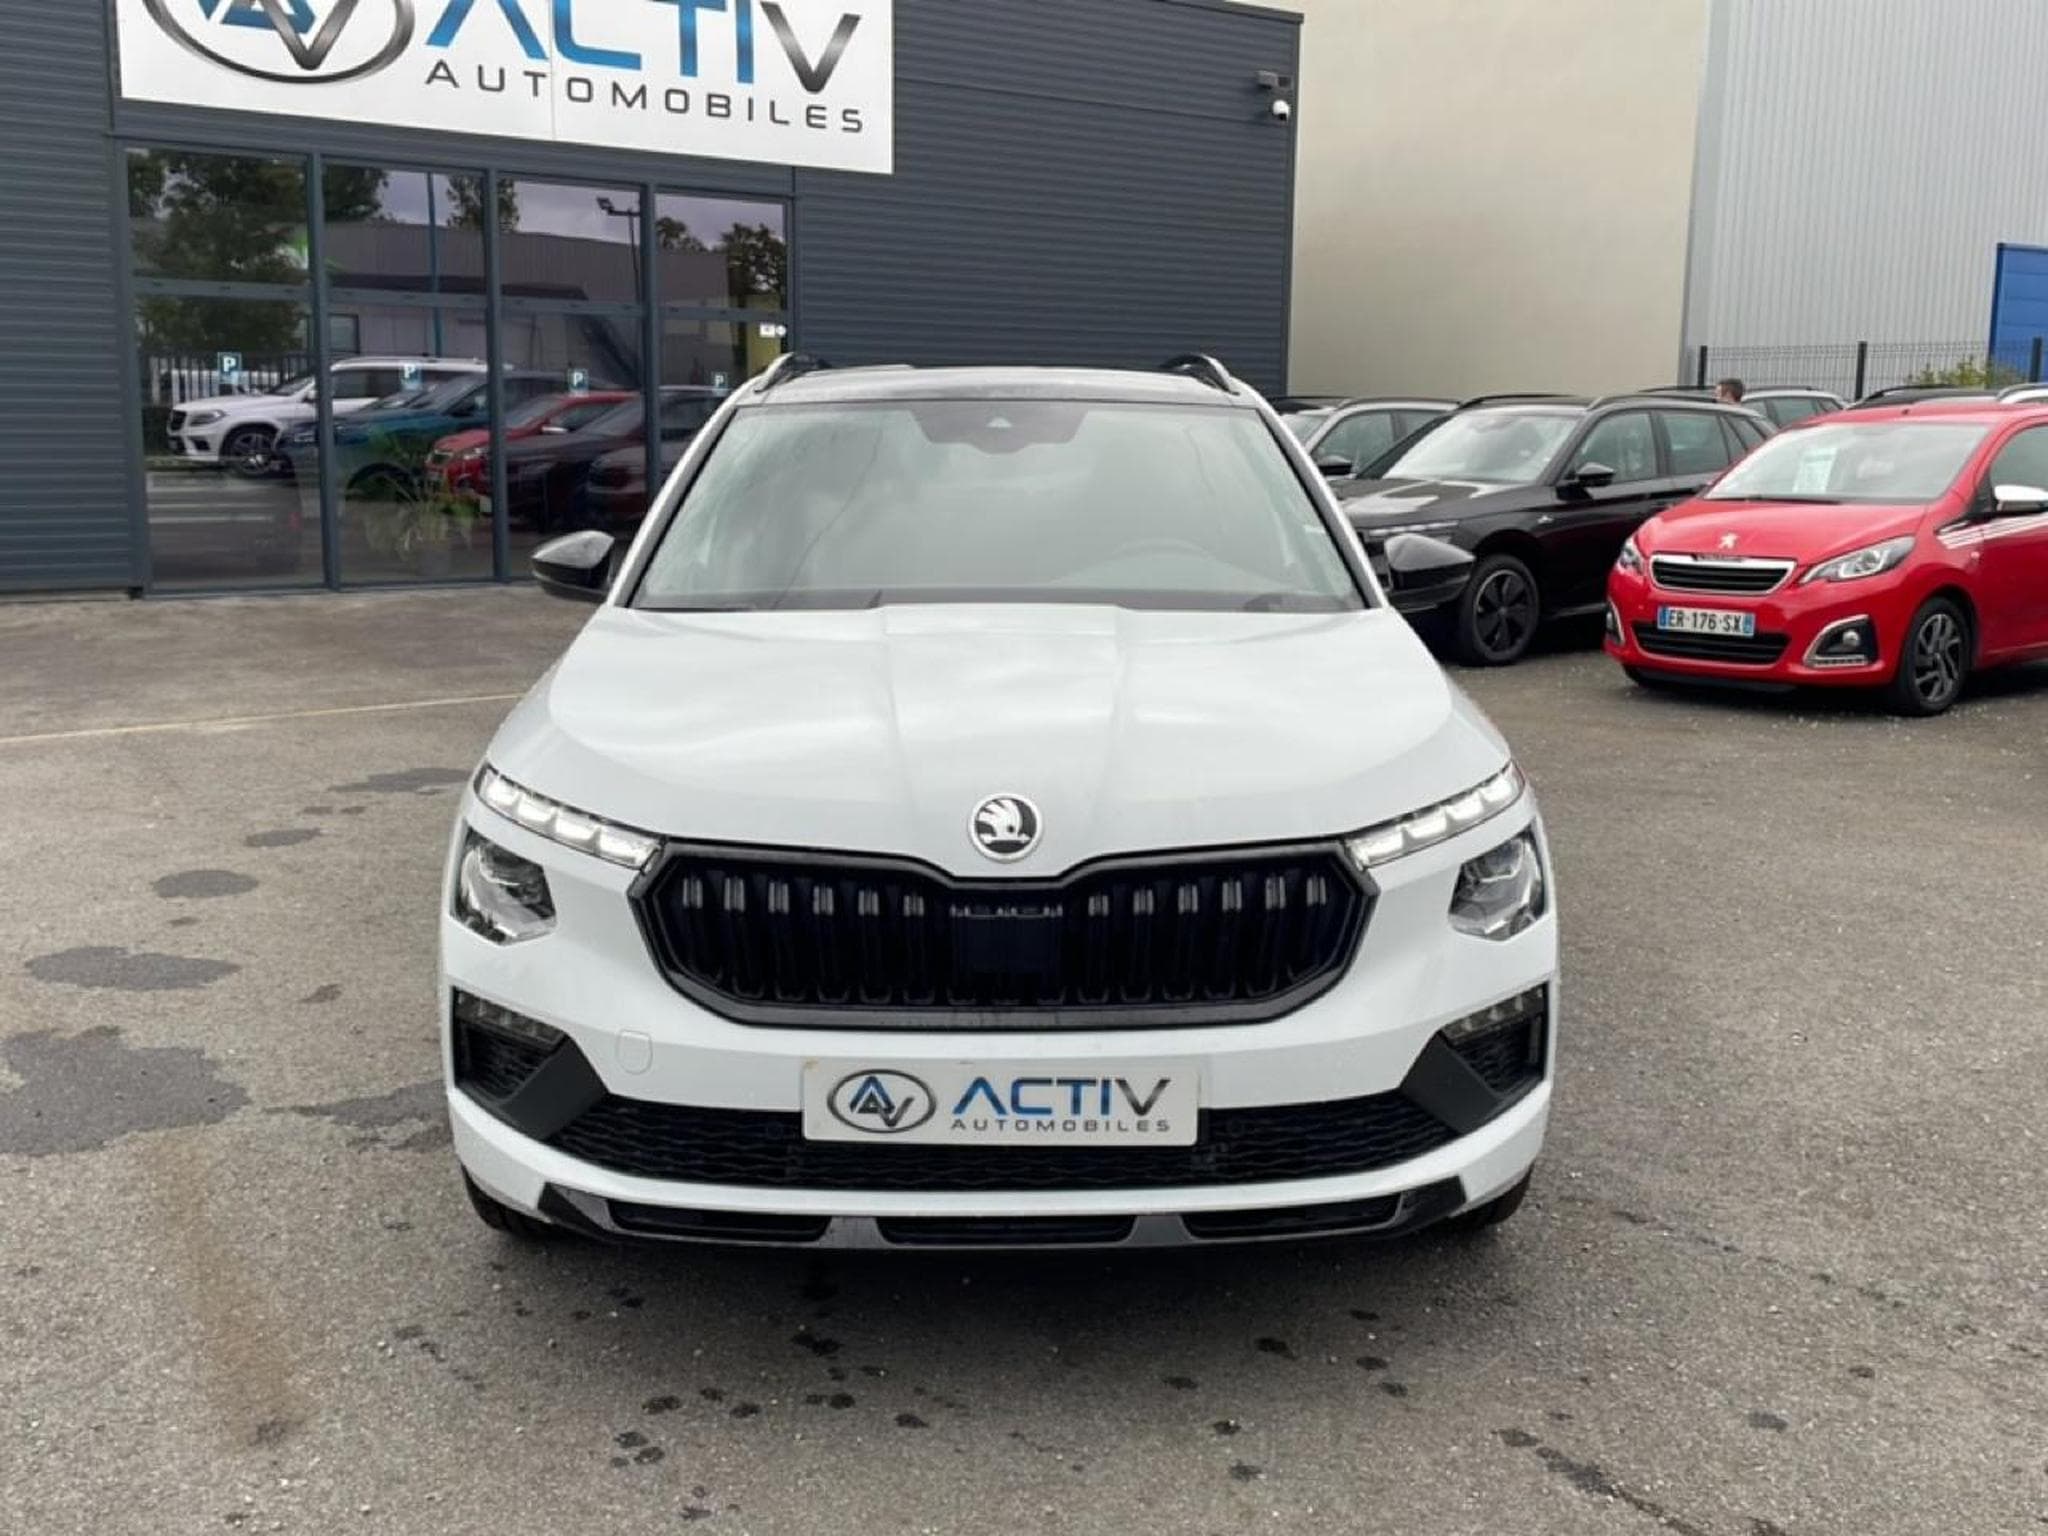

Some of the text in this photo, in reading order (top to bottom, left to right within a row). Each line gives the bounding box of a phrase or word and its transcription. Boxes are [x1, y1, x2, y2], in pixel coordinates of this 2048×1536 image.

[426, 0, 862, 94] ACTIV
[425, 59, 864, 134] AUTOMOBILES
[223, 356, 237, 373] P
[404, 363, 417, 379] P
[573, 371, 584, 387] P
[952, 1076, 1171, 1117] ACTIV
[951, 1118, 1171, 1133] AUTOMOBILES
